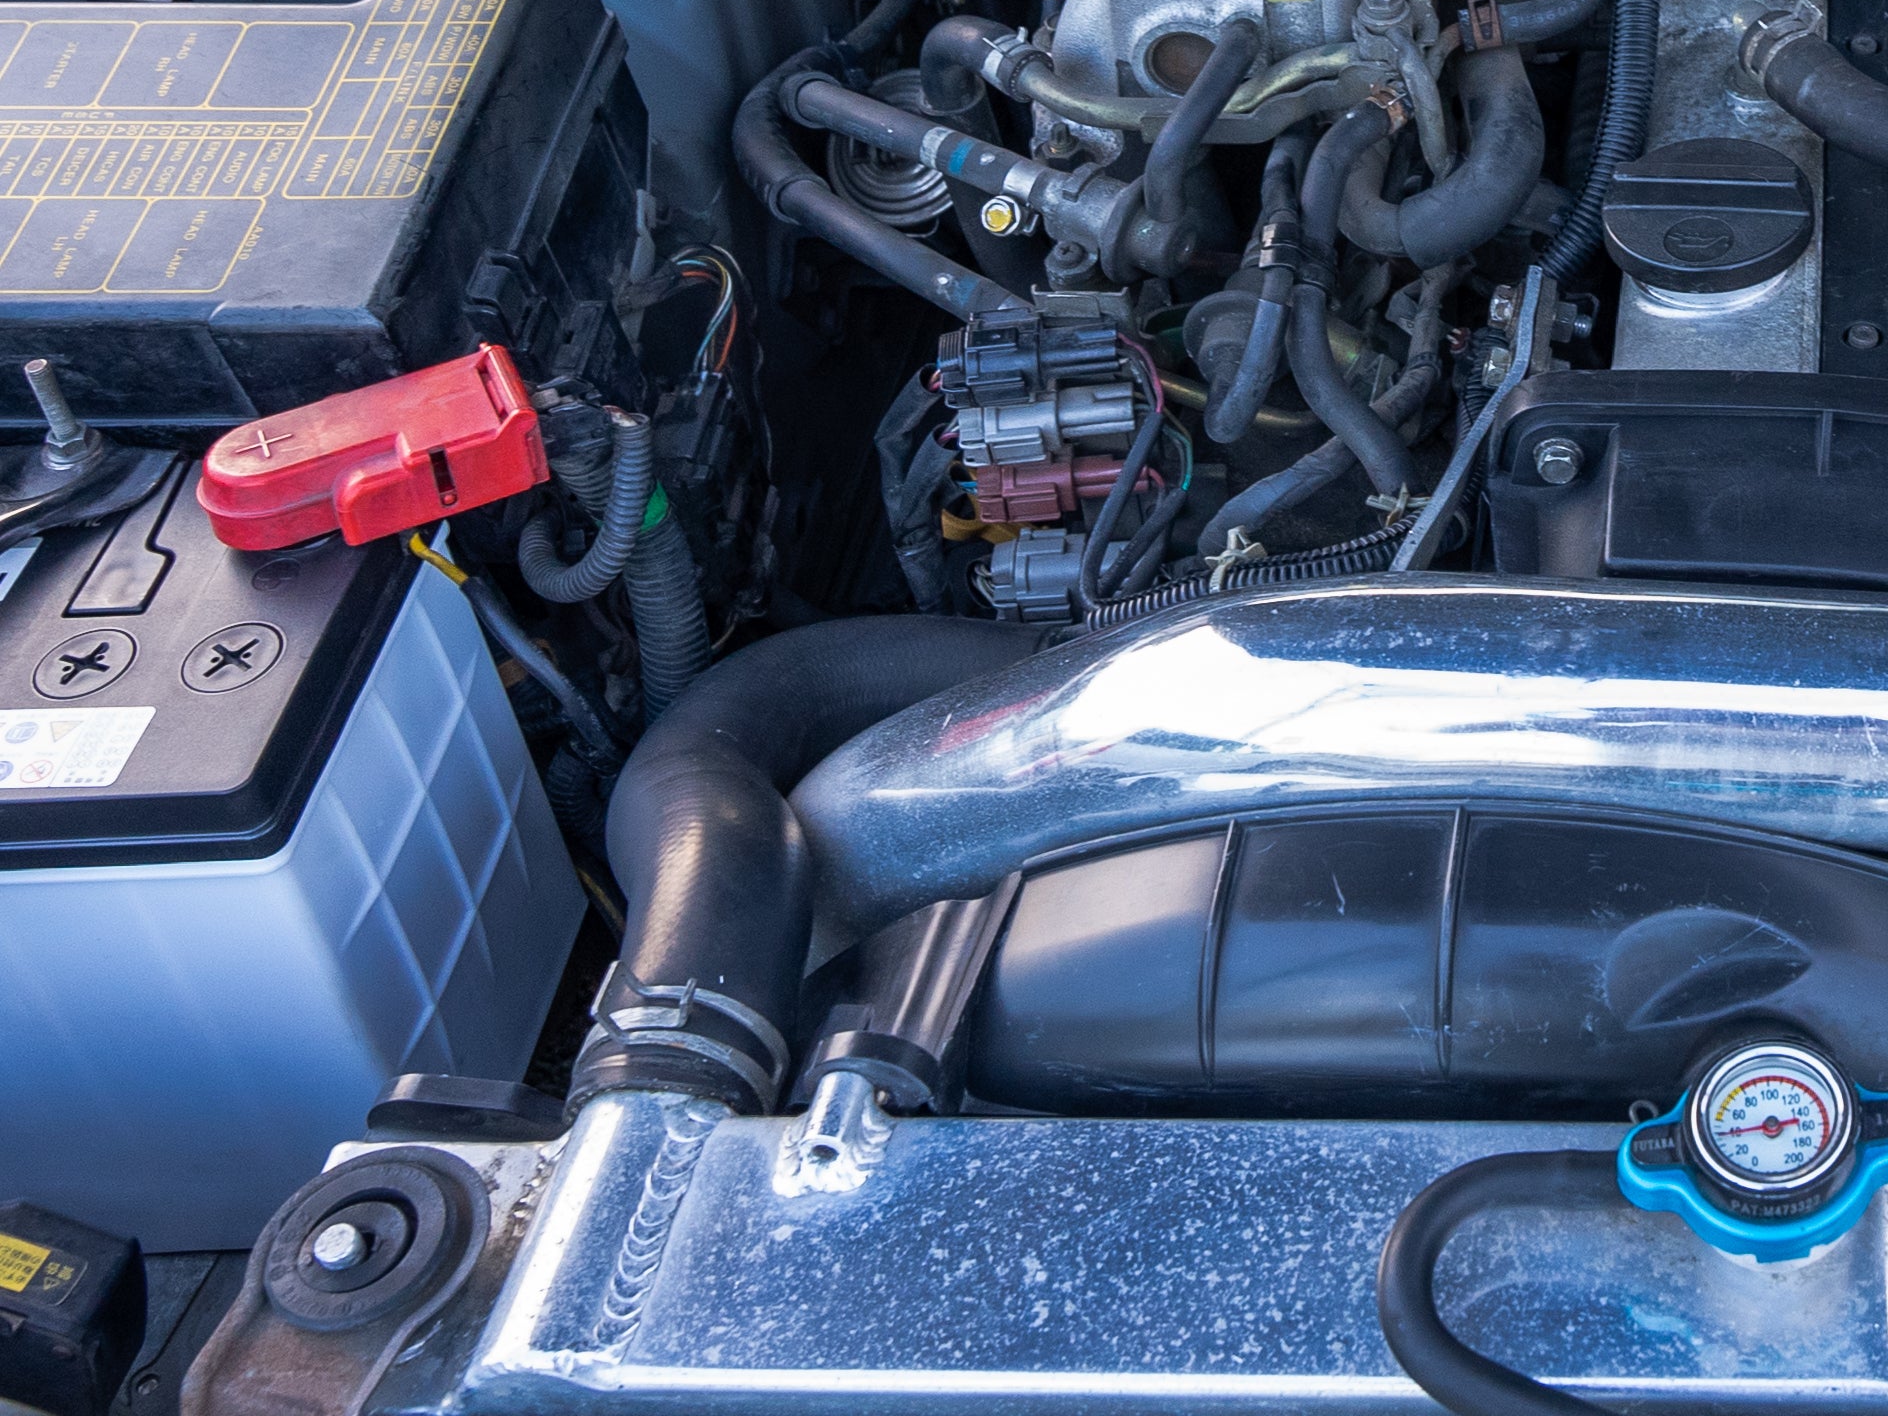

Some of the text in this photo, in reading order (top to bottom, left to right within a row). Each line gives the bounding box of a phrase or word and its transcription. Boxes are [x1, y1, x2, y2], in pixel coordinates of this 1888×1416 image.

[364, 37, 386, 66] MAIN
[154, 56, 172, 72] RH
[156, 32, 198, 98] HEAD LAMP
[31, 156, 53, 178] TCS
[59, 146, 90, 186] DEICER
[93, 150, 120, 184] HICAS
[121, 143, 156, 191] AIR CON
[153, 140, 190, 193] ENG CONT
[185, 141, 222, 193] ENG CONT
[222, 151, 249, 184] AUDIO
[252, 141, 286, 193] FOG LAMP
[305, 153, 329, 183] MAIN
[50, 235, 69, 251] LH
[53, 208, 101, 279] HEAD LAMP
[165, 209, 209, 279] HEAD LAMP
[1744, 1096, 1758, 1108] 80
[1760, 1089, 1779, 1101] 100
[1782, 1094, 1801, 1105] 120
[1732, 1108, 1746, 1120] 60
[1790, 1106, 1810, 1118] 140
[1796, 1119, 1815, 1132] 160
[1735, 1144, 1749, 1155] 20
[1793, 1137, 1812, 1149] 180
[1751, 1156, 1759, 1167] 0
[1784, 1152, 1804, 1165] 200
